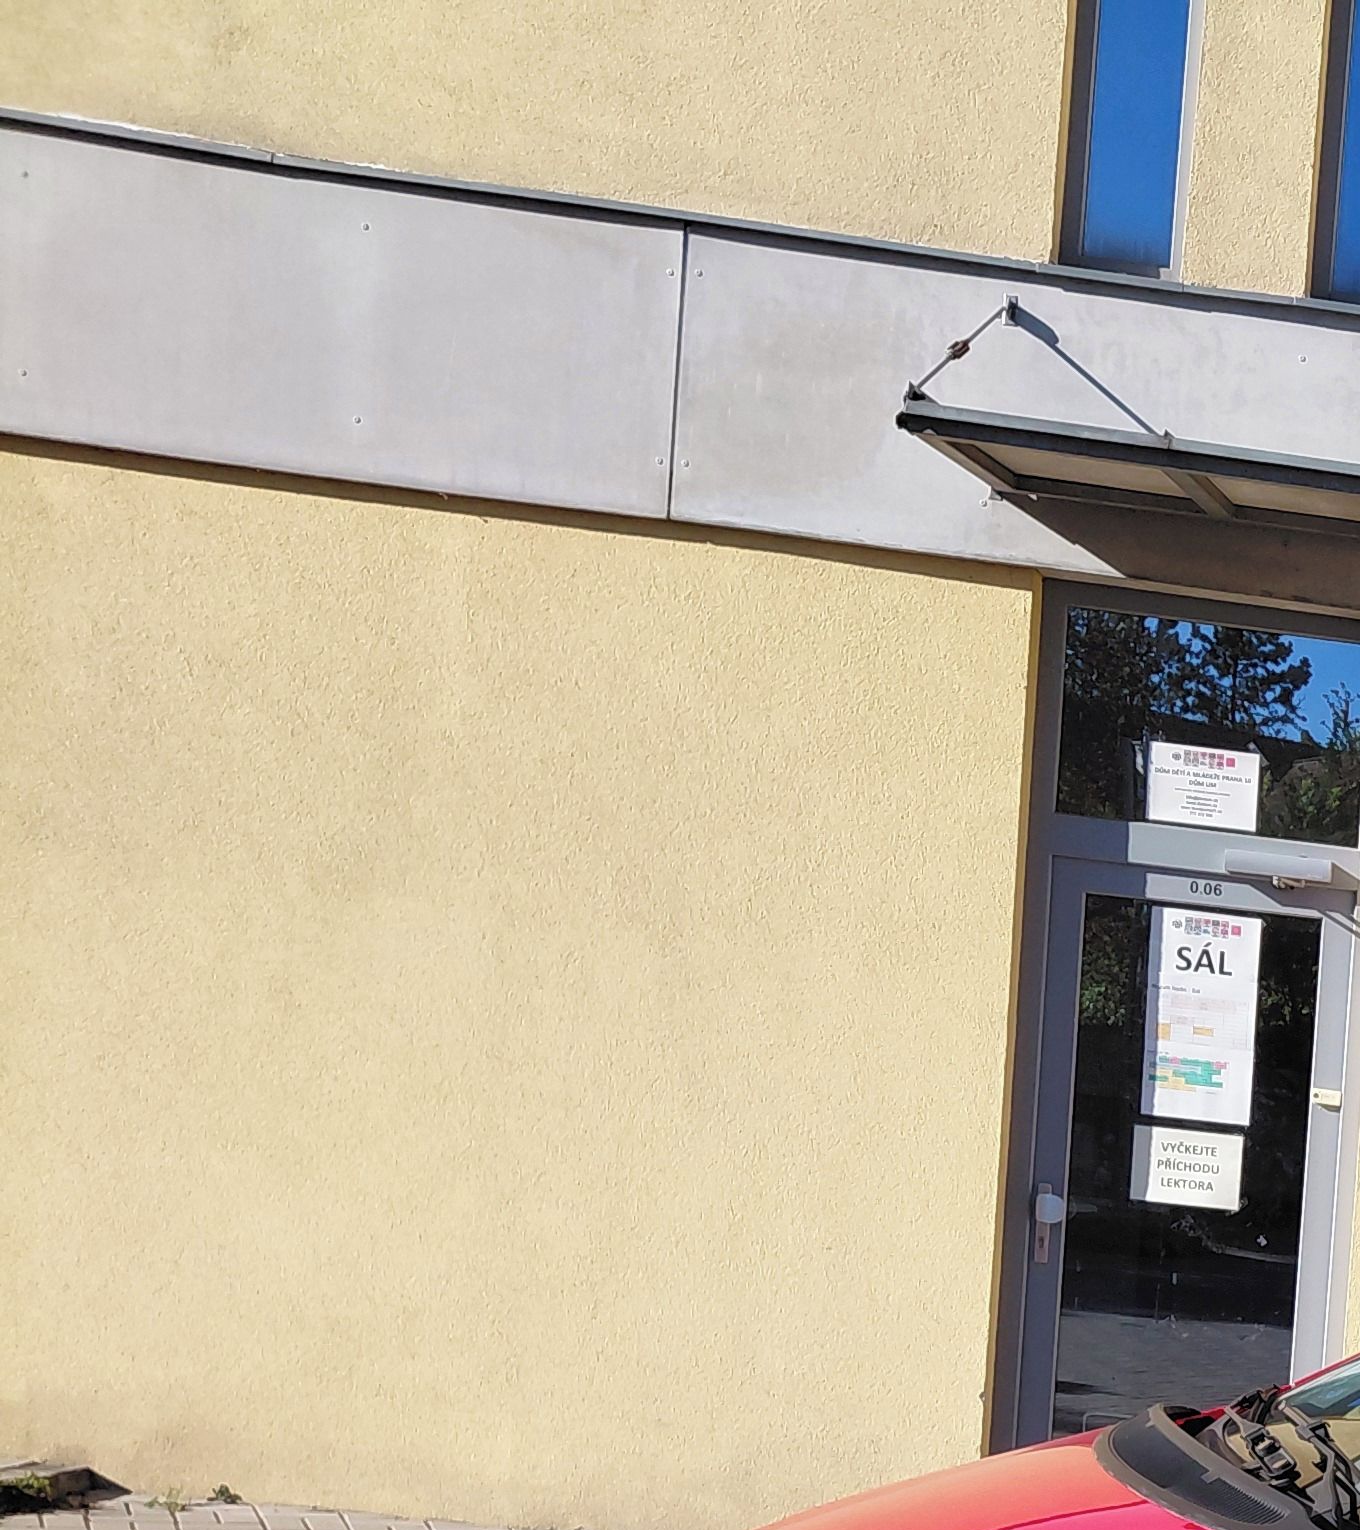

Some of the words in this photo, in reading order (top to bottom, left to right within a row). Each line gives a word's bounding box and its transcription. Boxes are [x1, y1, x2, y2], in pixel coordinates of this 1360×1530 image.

[1190, 880, 1223, 897] 0.06
[1175, 941, 1233, 977] SÁL
[1160, 1141, 1218, 1157] VYČKEJTE
[1156, 1158, 1220, 1175] PŘÍCHODU
[1160, 1177, 1214, 1192] LEKTORA
